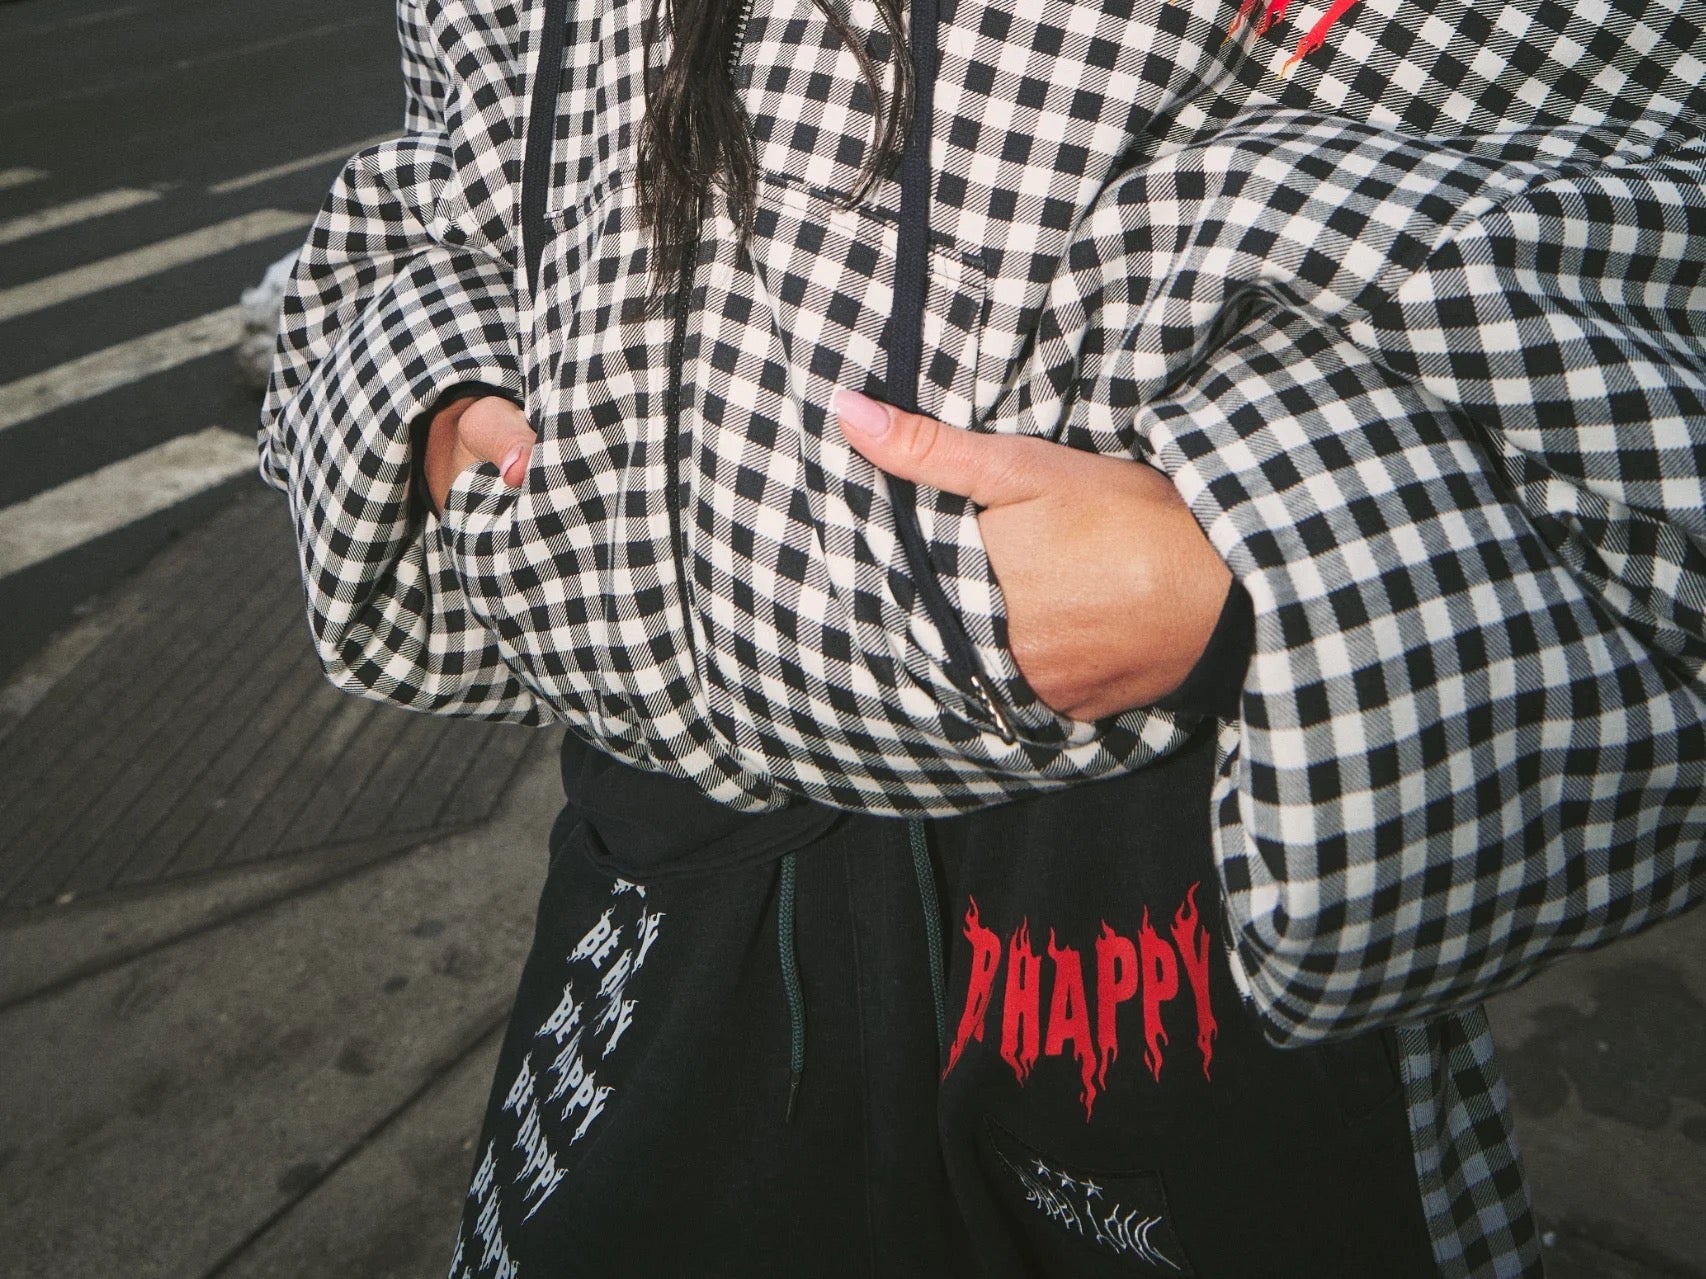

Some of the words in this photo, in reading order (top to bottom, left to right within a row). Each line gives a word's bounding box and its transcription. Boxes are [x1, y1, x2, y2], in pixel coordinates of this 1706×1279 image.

[566, 904, 624, 969] BE
[533, 977, 585, 1045] BE
[502, 1048, 539, 1118] BE
[466, 1134, 499, 1204] BE
[511, 1097, 569, 1226] HAPPY
